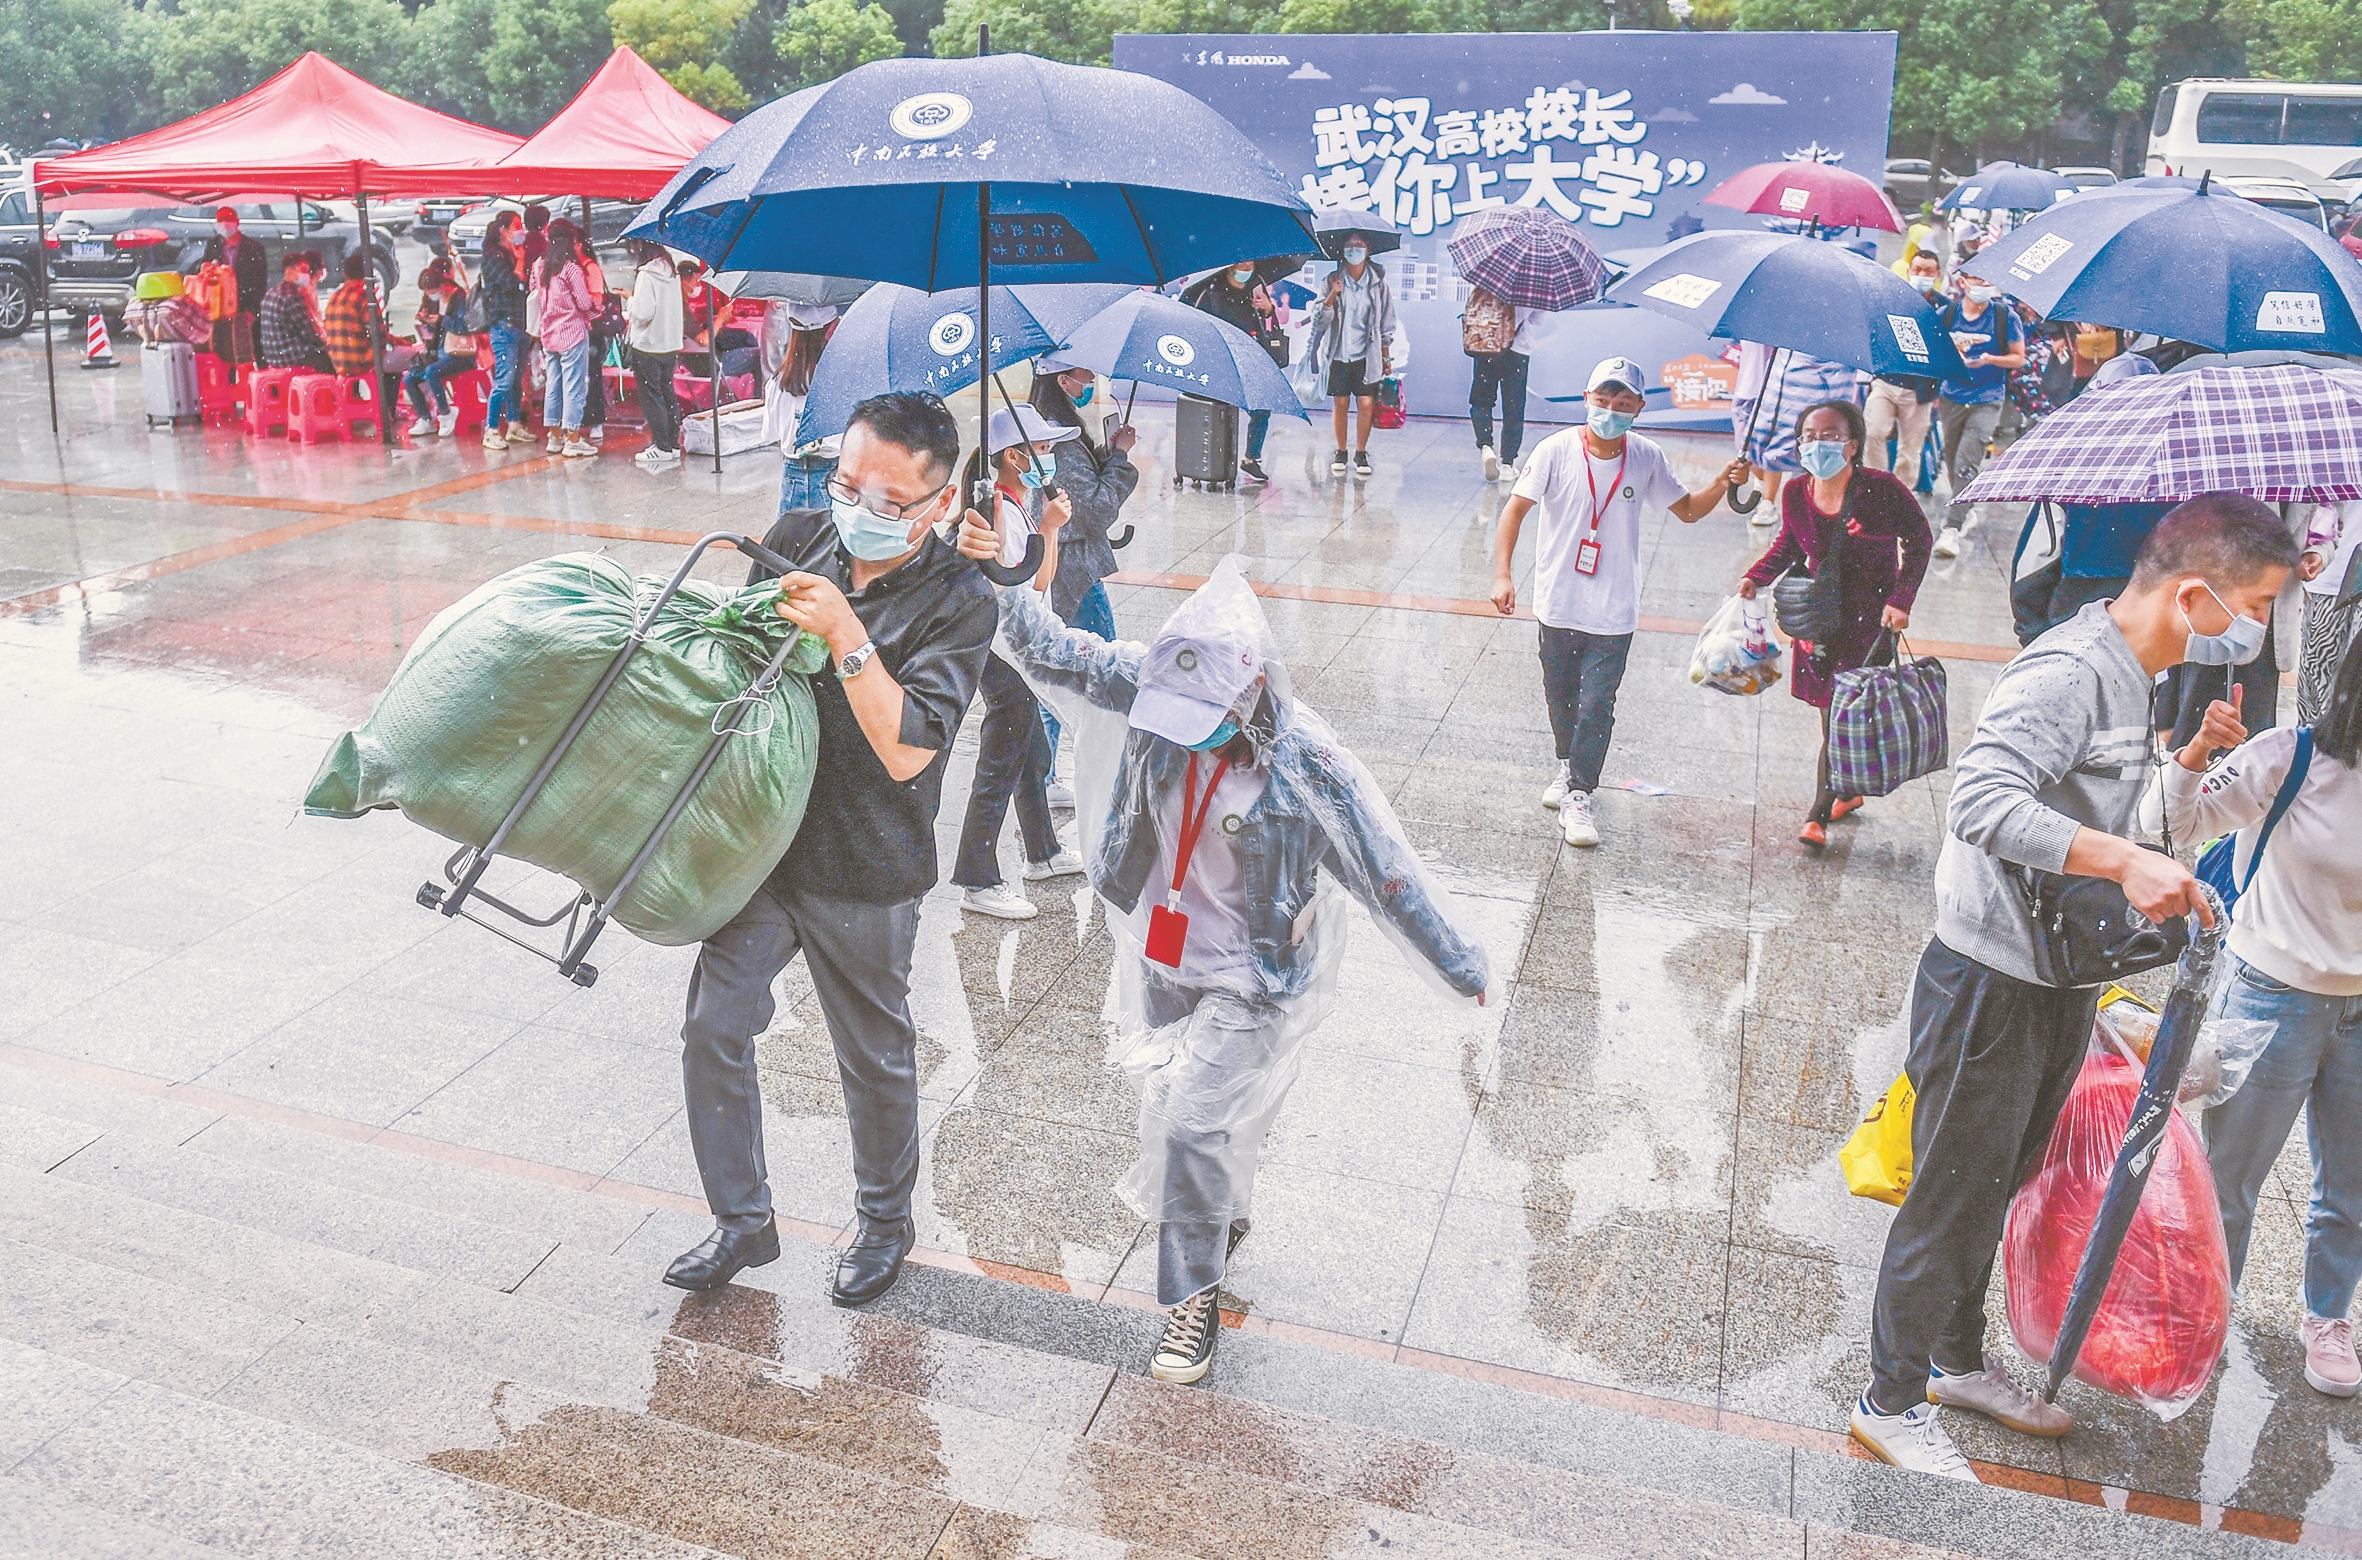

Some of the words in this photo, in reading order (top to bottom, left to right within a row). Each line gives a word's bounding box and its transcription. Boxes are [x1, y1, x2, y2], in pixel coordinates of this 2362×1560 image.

[1227, 55, 1291, 66] HONDA
[1313, 86, 1647, 168] 武汉高校校长
